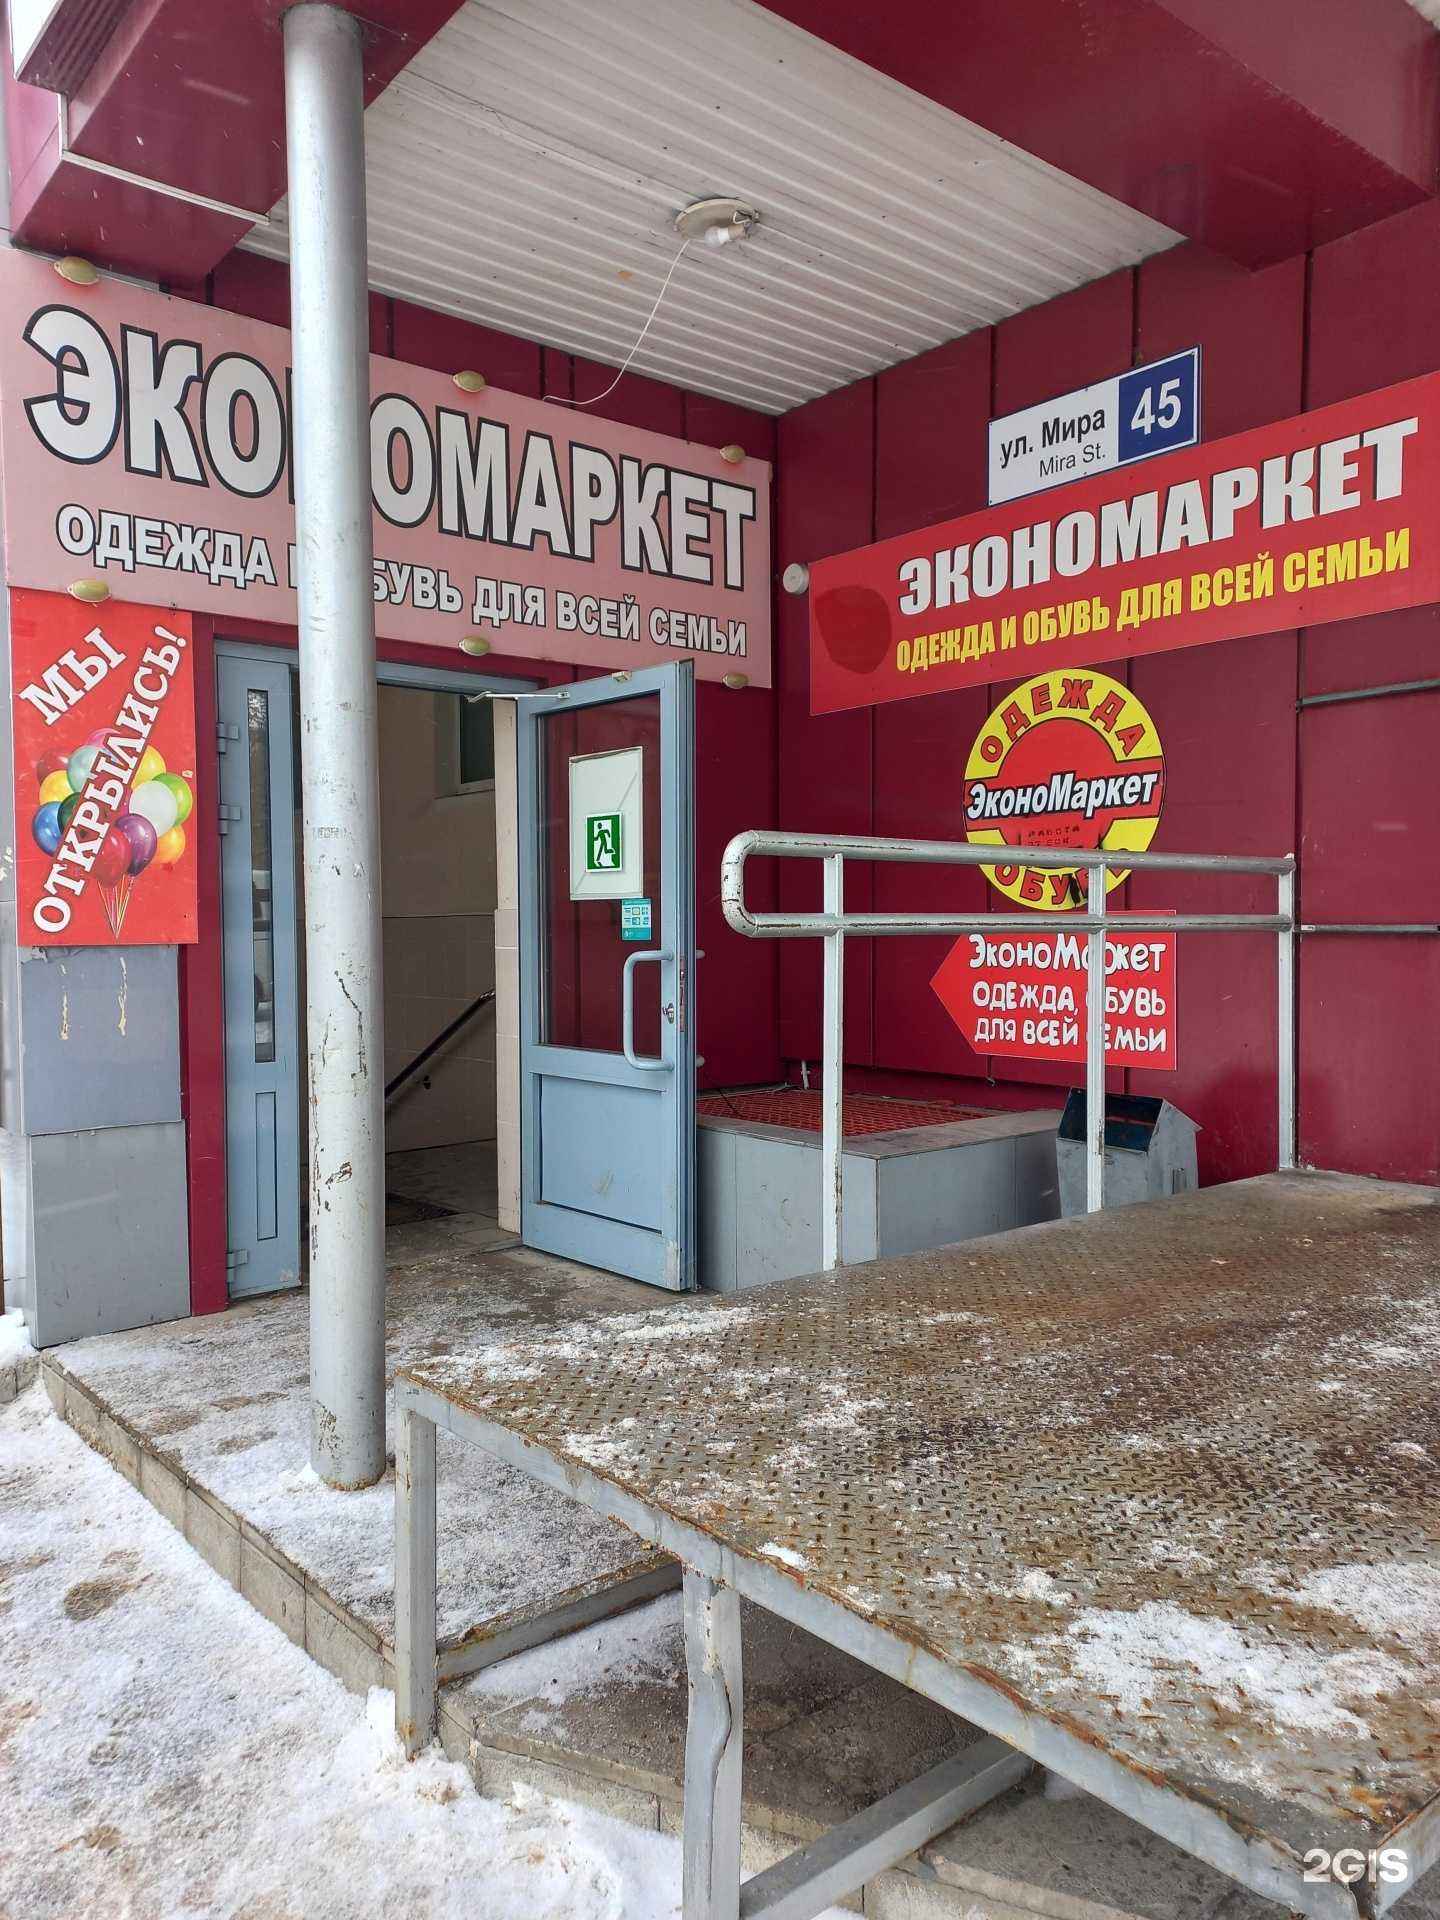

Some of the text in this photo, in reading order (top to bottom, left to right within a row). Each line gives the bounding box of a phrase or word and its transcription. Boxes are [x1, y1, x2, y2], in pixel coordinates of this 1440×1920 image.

[22, 304, 756, 591] ЭКООМАРКЕТ
[1000, 378, 1182, 469] ул. Мира 45
[1039, 443, 1106, 478] Mira St.
[897, 417, 1420, 616] ЭКОНОМАРКЕТ
[56, 503, 278, 589] ОДЕЖДА
[372, 558, 463, 614] БУВЬ
[472, 576, 547, 629] ДЛЯ
[555, 590, 641, 642] ВСЕЙ
[648, 607, 748, 658] СЕМЬИ
[896, 527, 1411, 673] ОДЕЖДА И ОБУВЬ ДЛЯ ВСЕЙ СЕМЬИ
[19, 626, 128, 727] МЫ
[980, 678, 1146, 763] ОДЕЖДА
[33, 625, 188, 934] ОТКРЫЛИСЬ!
[966, 770, 1161, 819] ЭконоМаркет
[995, 864, 1128, 906] ОБУ
[972, 980, 1167, 1018] ОДЕЖДА, БУВЬ
[974, 1015, 1167, 1053] ДЛЯ ВСЕЙ ЕМЬИ
